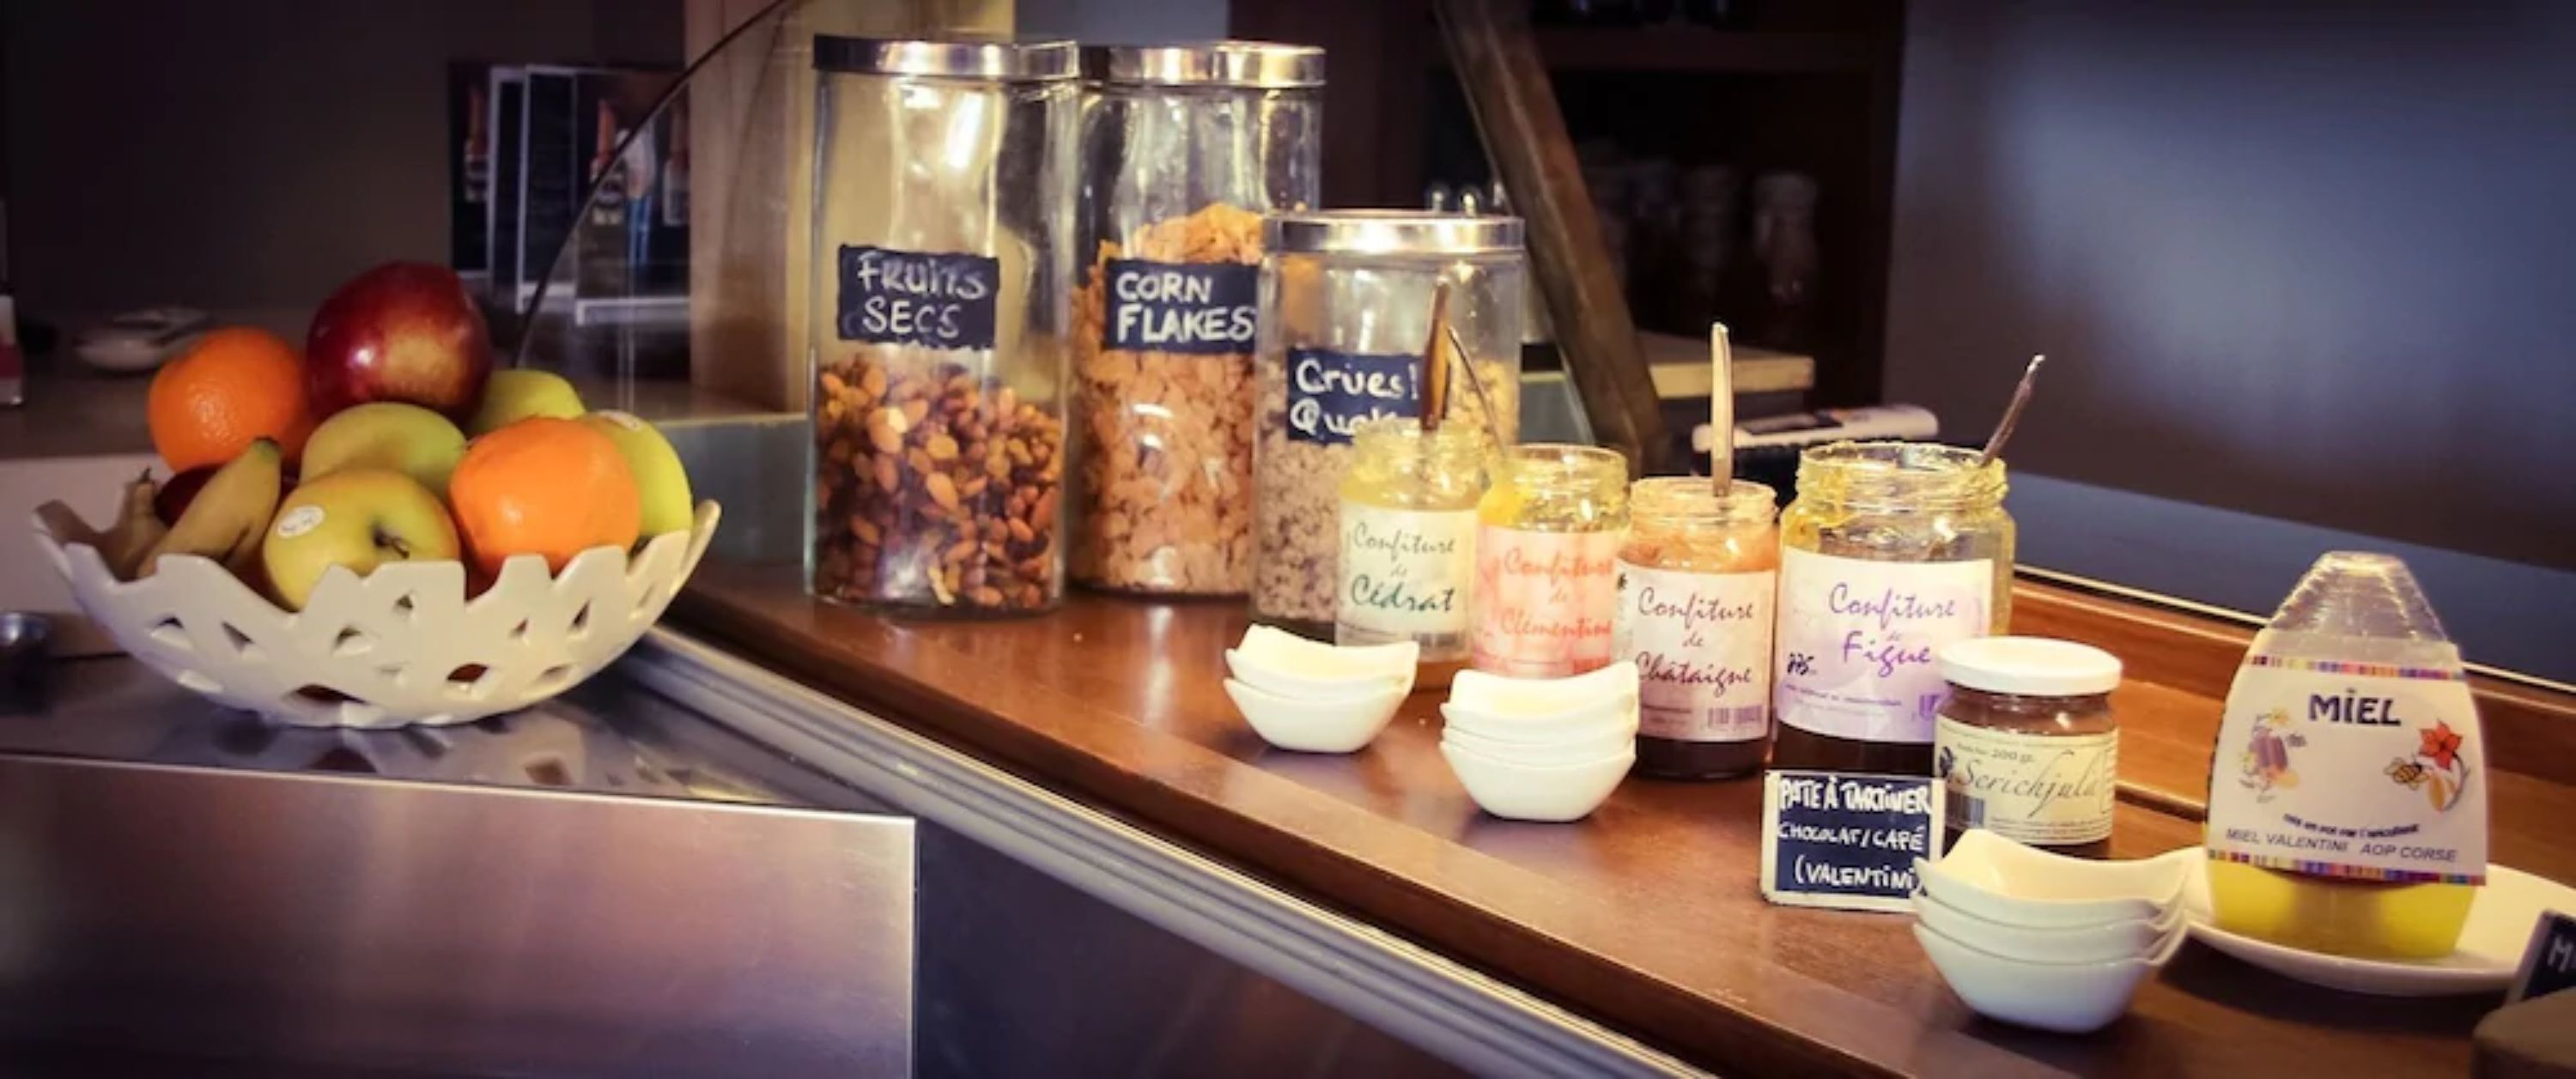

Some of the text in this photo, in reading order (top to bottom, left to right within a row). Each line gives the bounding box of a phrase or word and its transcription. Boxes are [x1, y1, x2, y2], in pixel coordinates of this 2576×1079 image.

[1116, 271, 1213, 304] CORN
[862, 295, 961, 338] SECS
[1118, 303, 1256, 342] FLAKES
[1354, 521, 1455, 561] Confiture
[1504, 546, 1613, 586] Confiture
[1351, 573, 1455, 612] Cédrat
[1637, 586, 1753, 630] Confiture
[1828, 581, 1956, 630] Confiture
[1682, 631, 1704, 647] de
[1841, 630, 1932, 678] Figue
[1635, 650, 1753, 699] Châtaigne
[2266, 832, 2350, 853] VALENTINI
[2359, 842, 2397, 857] AOP
[2399, 846, 2458, 864] CORSE
